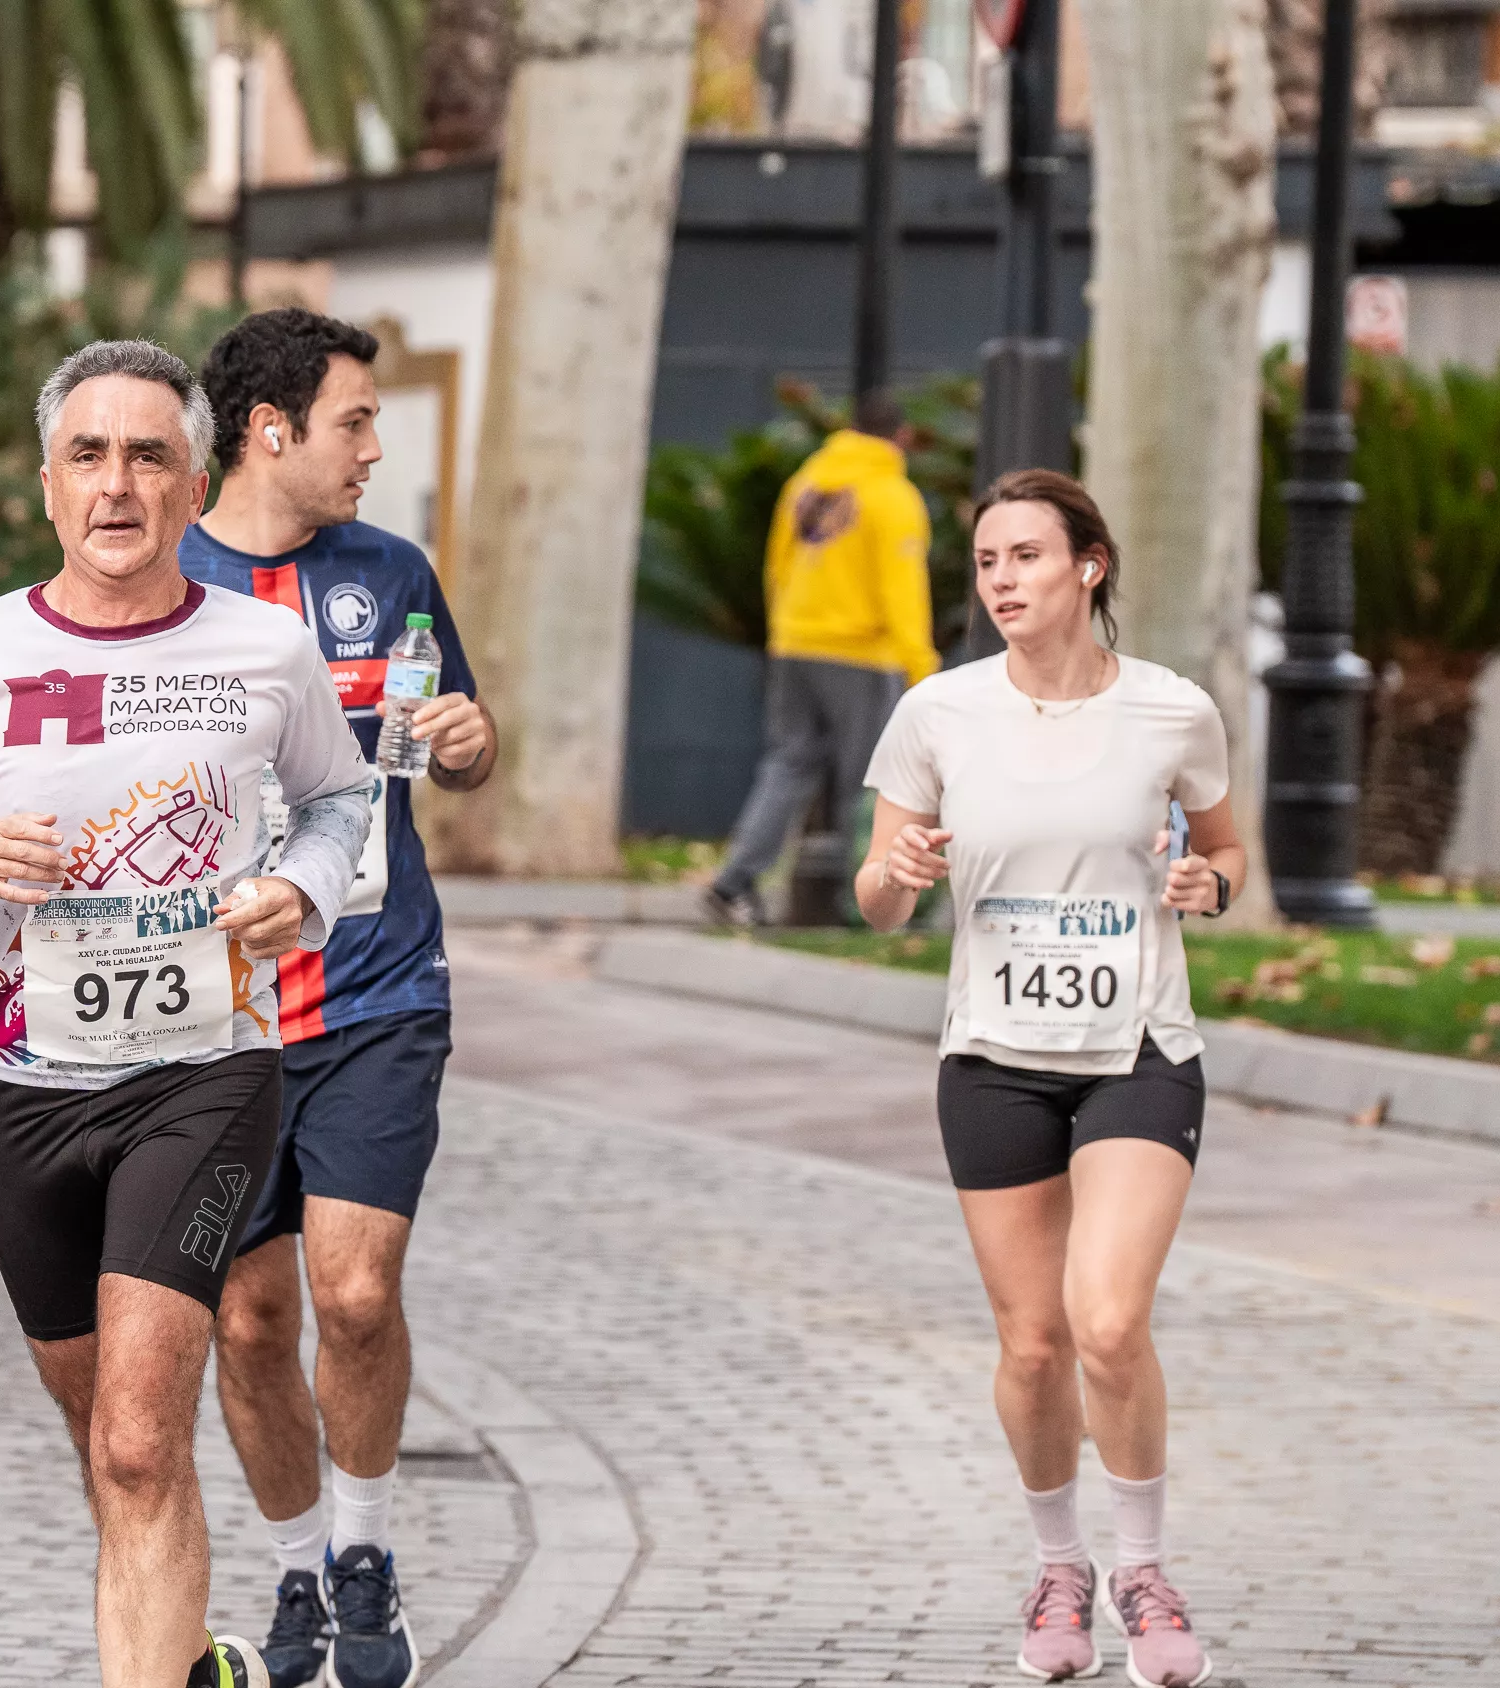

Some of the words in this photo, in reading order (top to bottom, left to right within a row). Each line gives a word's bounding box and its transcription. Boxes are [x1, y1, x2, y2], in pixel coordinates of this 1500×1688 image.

[336, 641, 375, 658] FAMPY
[45, 682, 66, 694] 35
[110, 675, 146, 693] 35
[156, 674, 247, 694] MEDIA
[110, 694, 247, 716] MARATÓN
[69, 898, 119, 909] PROVINCIAL
[121, 897, 132, 907] DE
[132, 890, 184, 915] 2024
[33, 908, 77, 920] CARRERAS
[80, 906, 133, 918] POPULARES
[95, 917, 134, 925] CÓRDOBA
[78, 950, 96, 958] XXV
[112, 946, 141, 956] CIUDAD
[154, 941, 182, 951] LUCENA
[125, 954, 165, 965] IGUALDAD
[73, 964, 190, 1023] 973
[994, 962, 1118, 1009] 1430
[68, 1034, 87, 1042] JOSE
[153, 1024, 198, 1036] GONZALEZ
